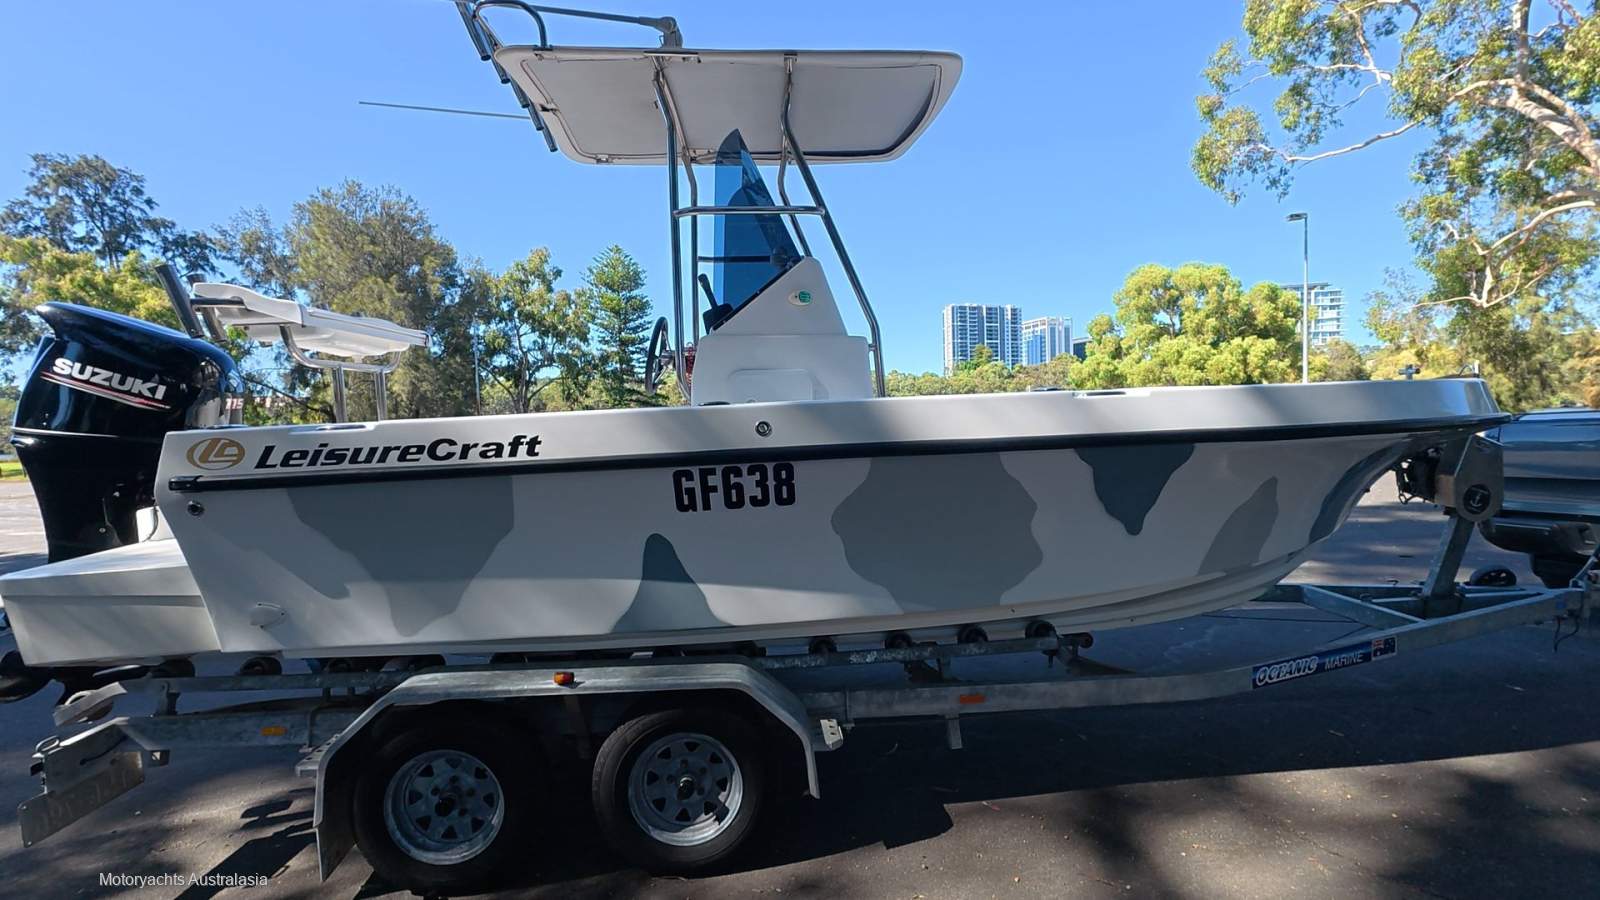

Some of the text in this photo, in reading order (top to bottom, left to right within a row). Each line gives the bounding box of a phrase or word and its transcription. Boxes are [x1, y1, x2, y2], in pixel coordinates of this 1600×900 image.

[52, 357, 167, 400] SUZUKI
[254, 434, 543, 470] LeisureCraft
[672, 462, 796, 513] GF638
[1256, 651, 1364, 686] OCEANIC MARINE
